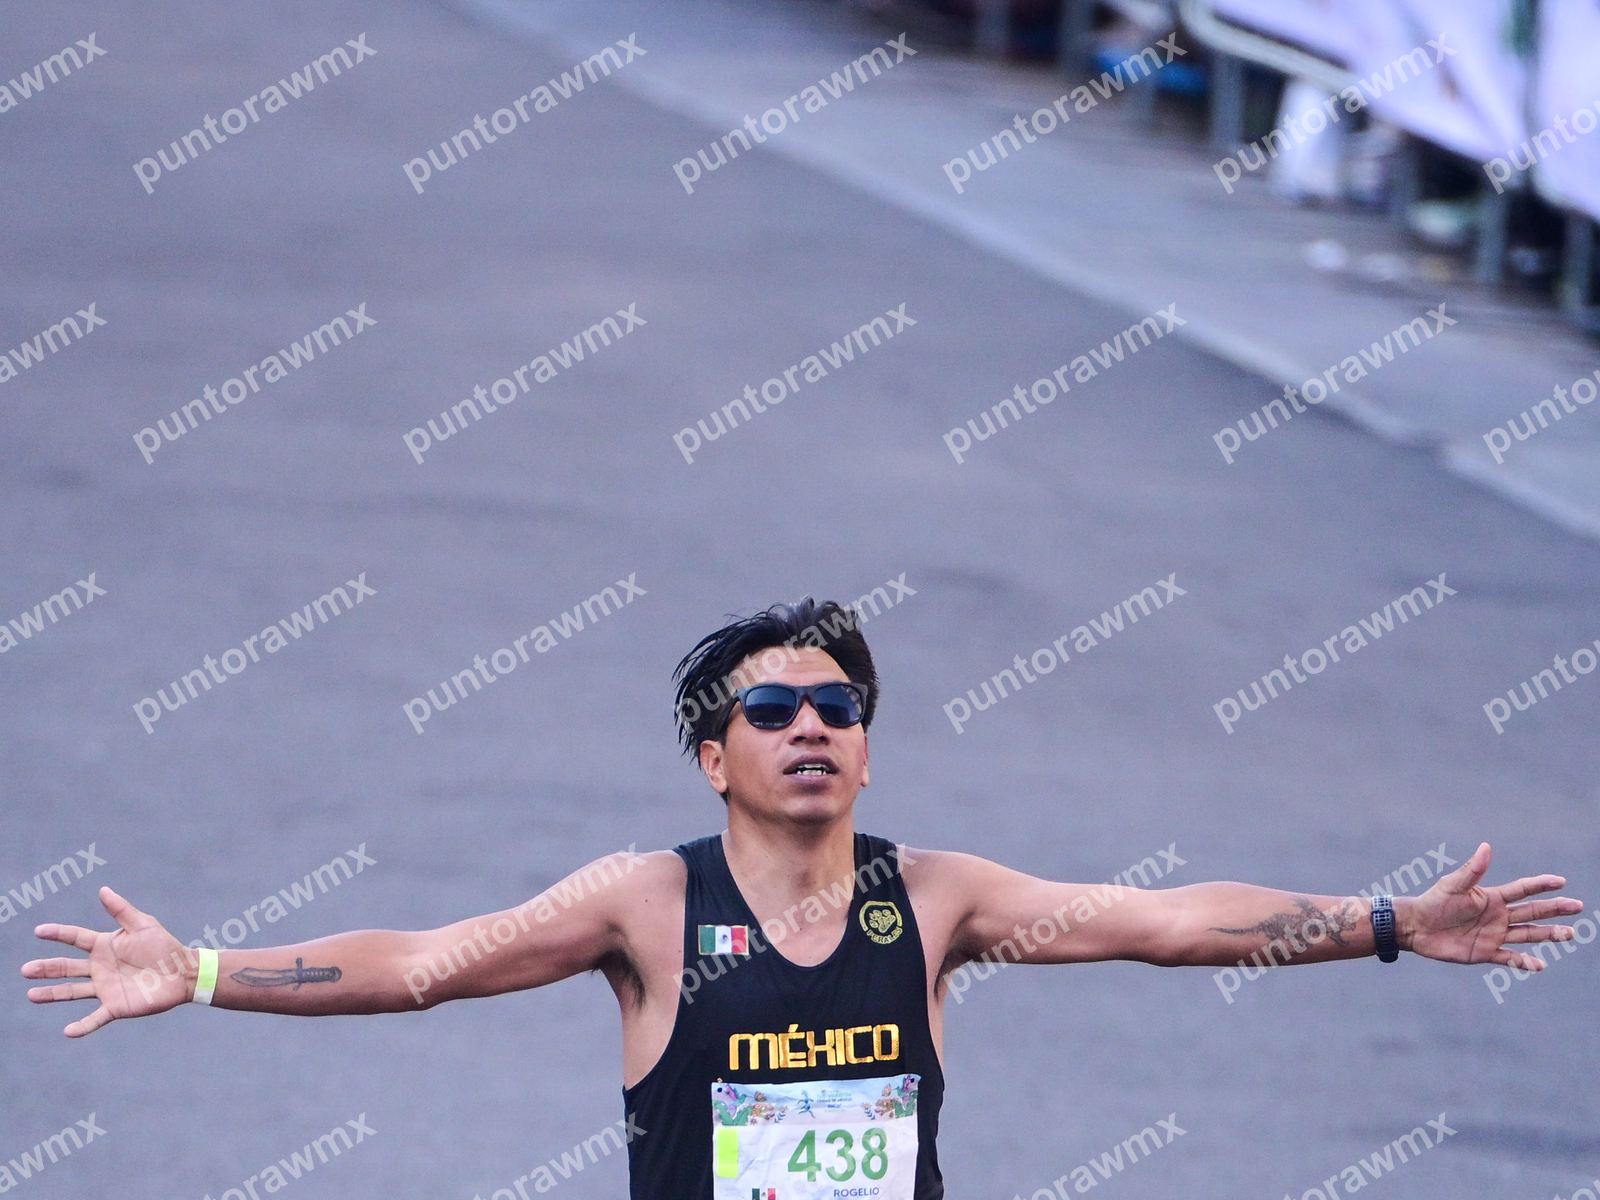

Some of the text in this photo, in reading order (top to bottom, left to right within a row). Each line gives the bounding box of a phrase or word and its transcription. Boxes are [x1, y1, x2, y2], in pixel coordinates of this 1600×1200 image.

[729, 1023, 899, 1070] MÉXICO
[787, 1127, 889, 1182] 438
[833, 1187, 880, 1198] ROGELIO
